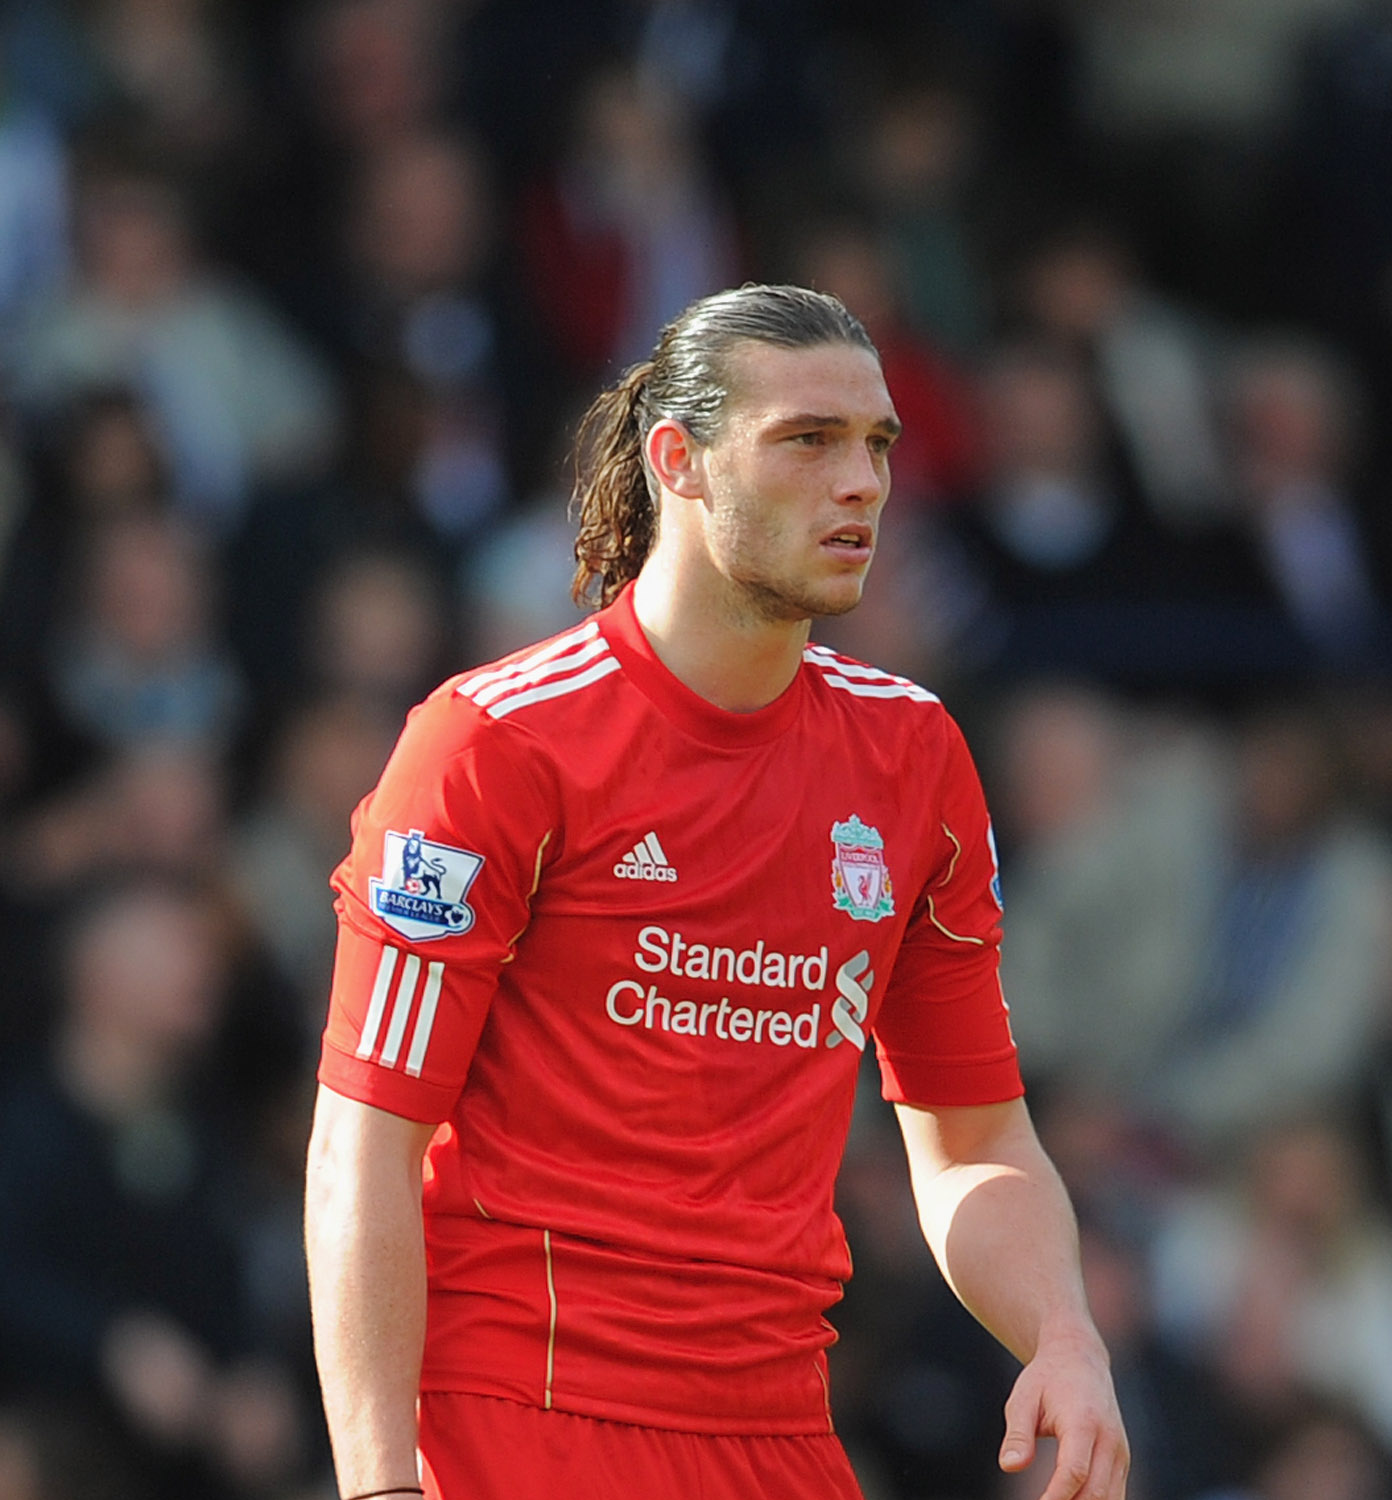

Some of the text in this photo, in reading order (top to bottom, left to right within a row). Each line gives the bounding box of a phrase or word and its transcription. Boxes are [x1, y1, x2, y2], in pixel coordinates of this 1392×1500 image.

[613, 863, 677, 882] adidas
[380, 891, 443, 917] BARCLAYS
[634, 926, 828, 990] Standard
[606, 980, 820, 1048] Chartered
